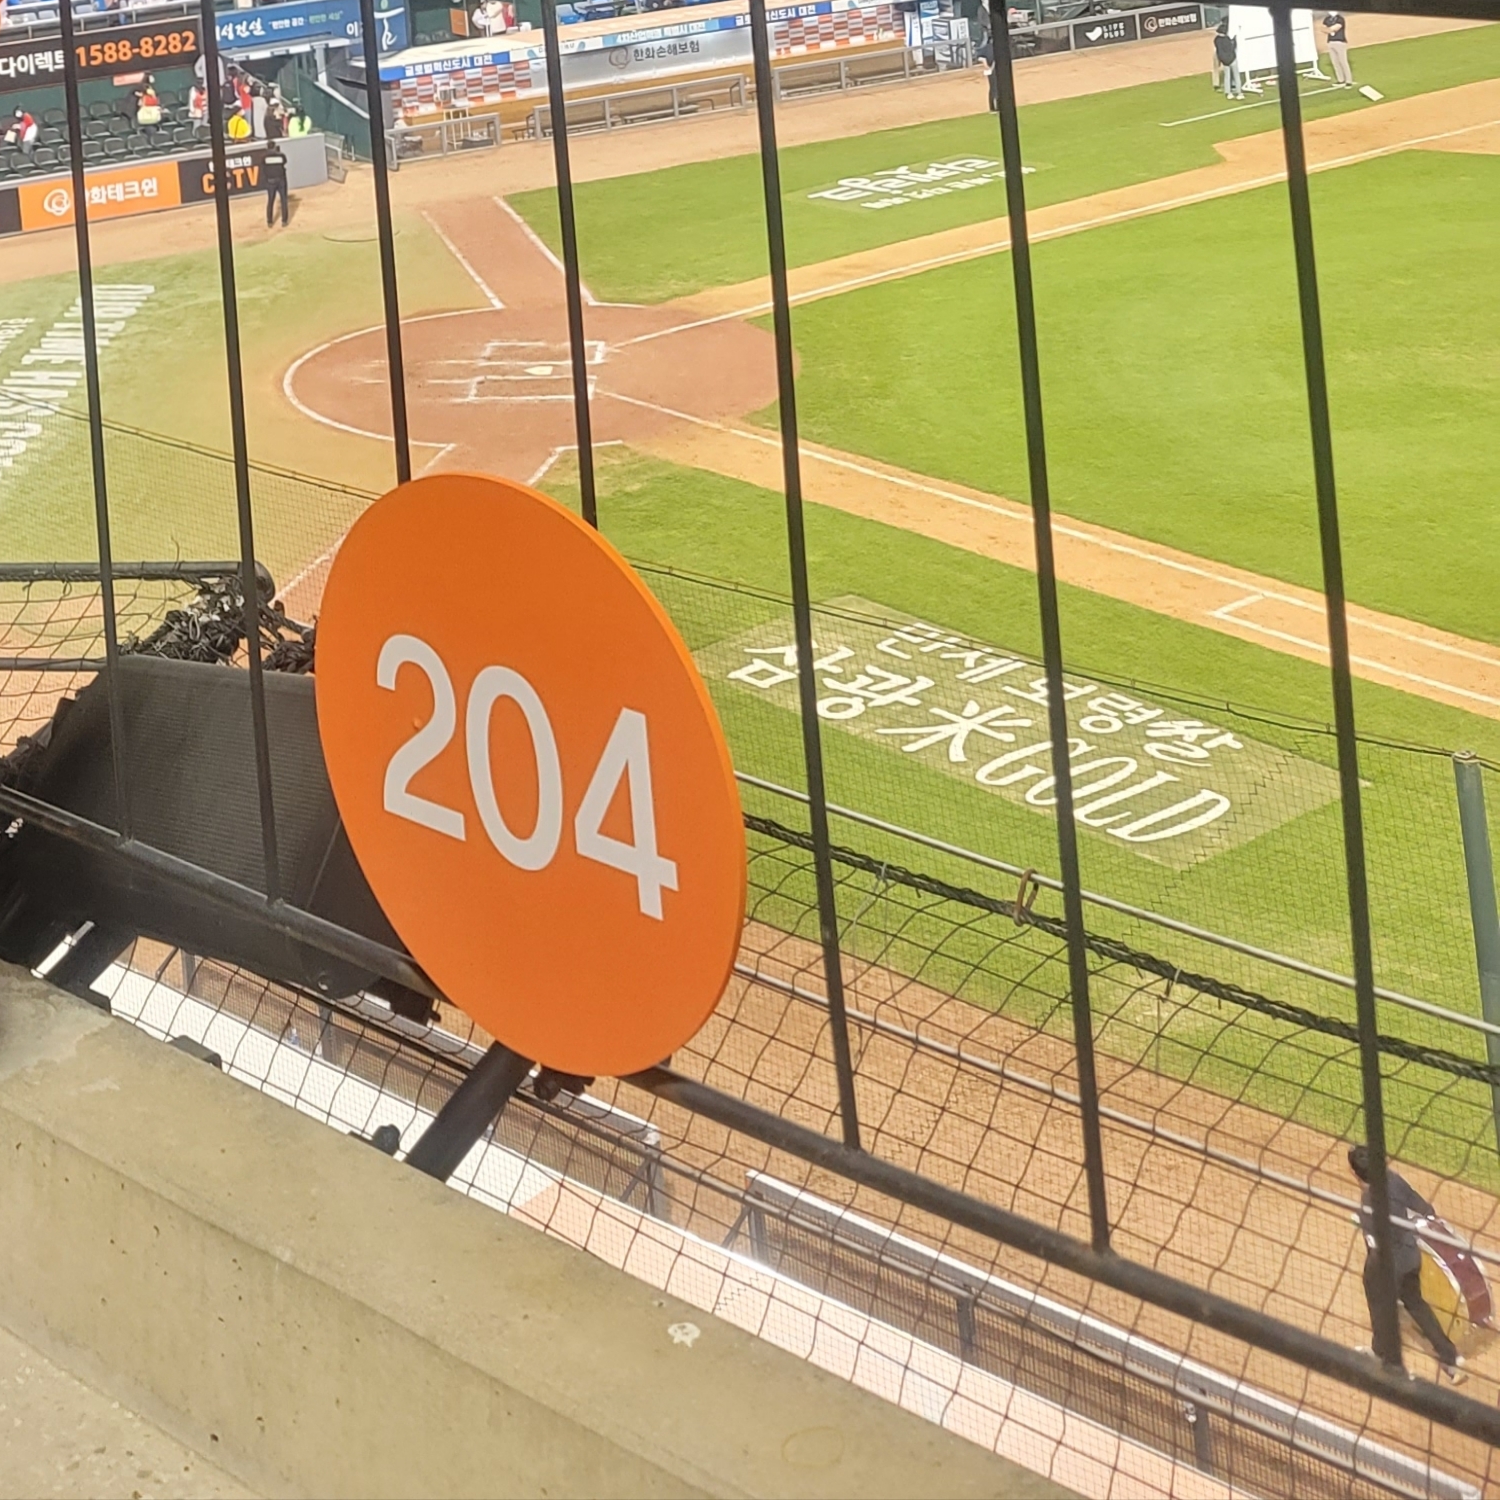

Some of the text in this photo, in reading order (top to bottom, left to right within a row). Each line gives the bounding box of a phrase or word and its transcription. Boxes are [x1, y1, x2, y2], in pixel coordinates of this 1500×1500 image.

[799, 4, 817, 17] 대전
[215, 17, 266, 42] 성건설
[1103, 22, 1125, 32] LIFE
[1104, 30, 1125, 40] PLUS
[75, 30, 197, 67] 1588-8282
[633, 40, 701, 62] 한화손해보험
[404, 55, 494, 77] 글로벌혁신도시 대전
[84, 176, 159, 205] 화테크윈
[63, 284, 156, 318] OUR
[20, 320, 126, 366] TIME
[376, 633, 680, 922] 204
